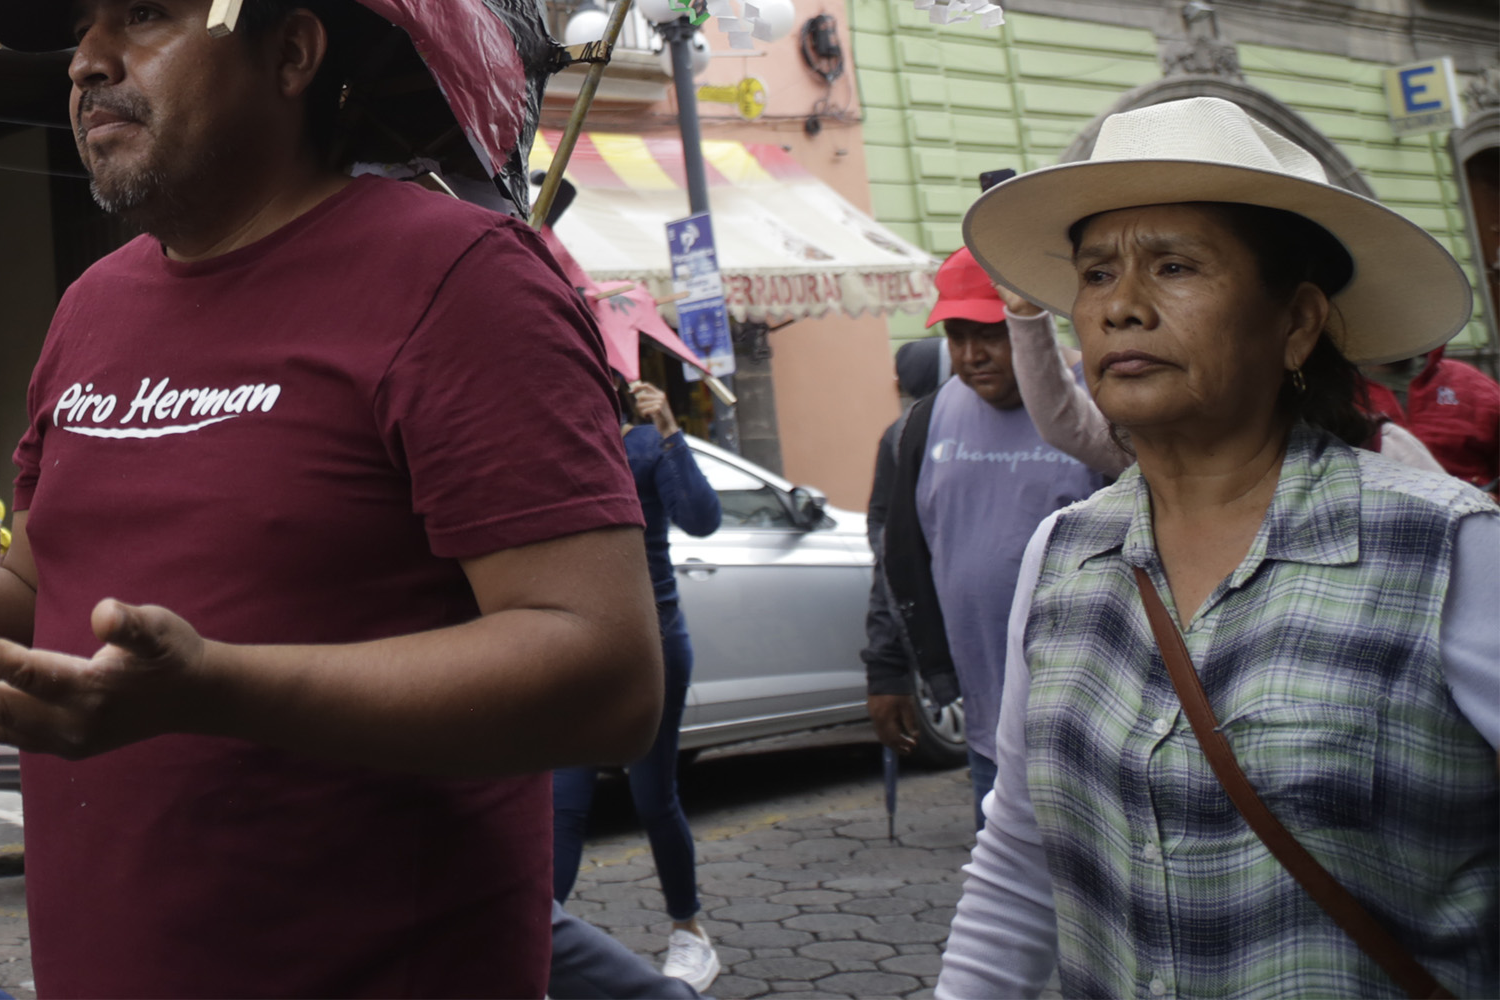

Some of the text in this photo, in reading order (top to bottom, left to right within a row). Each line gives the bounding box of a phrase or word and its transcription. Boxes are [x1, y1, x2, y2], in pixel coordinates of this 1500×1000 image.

[1399, 66, 1441, 112] E
[53, 376, 282, 427] Piro Herman
